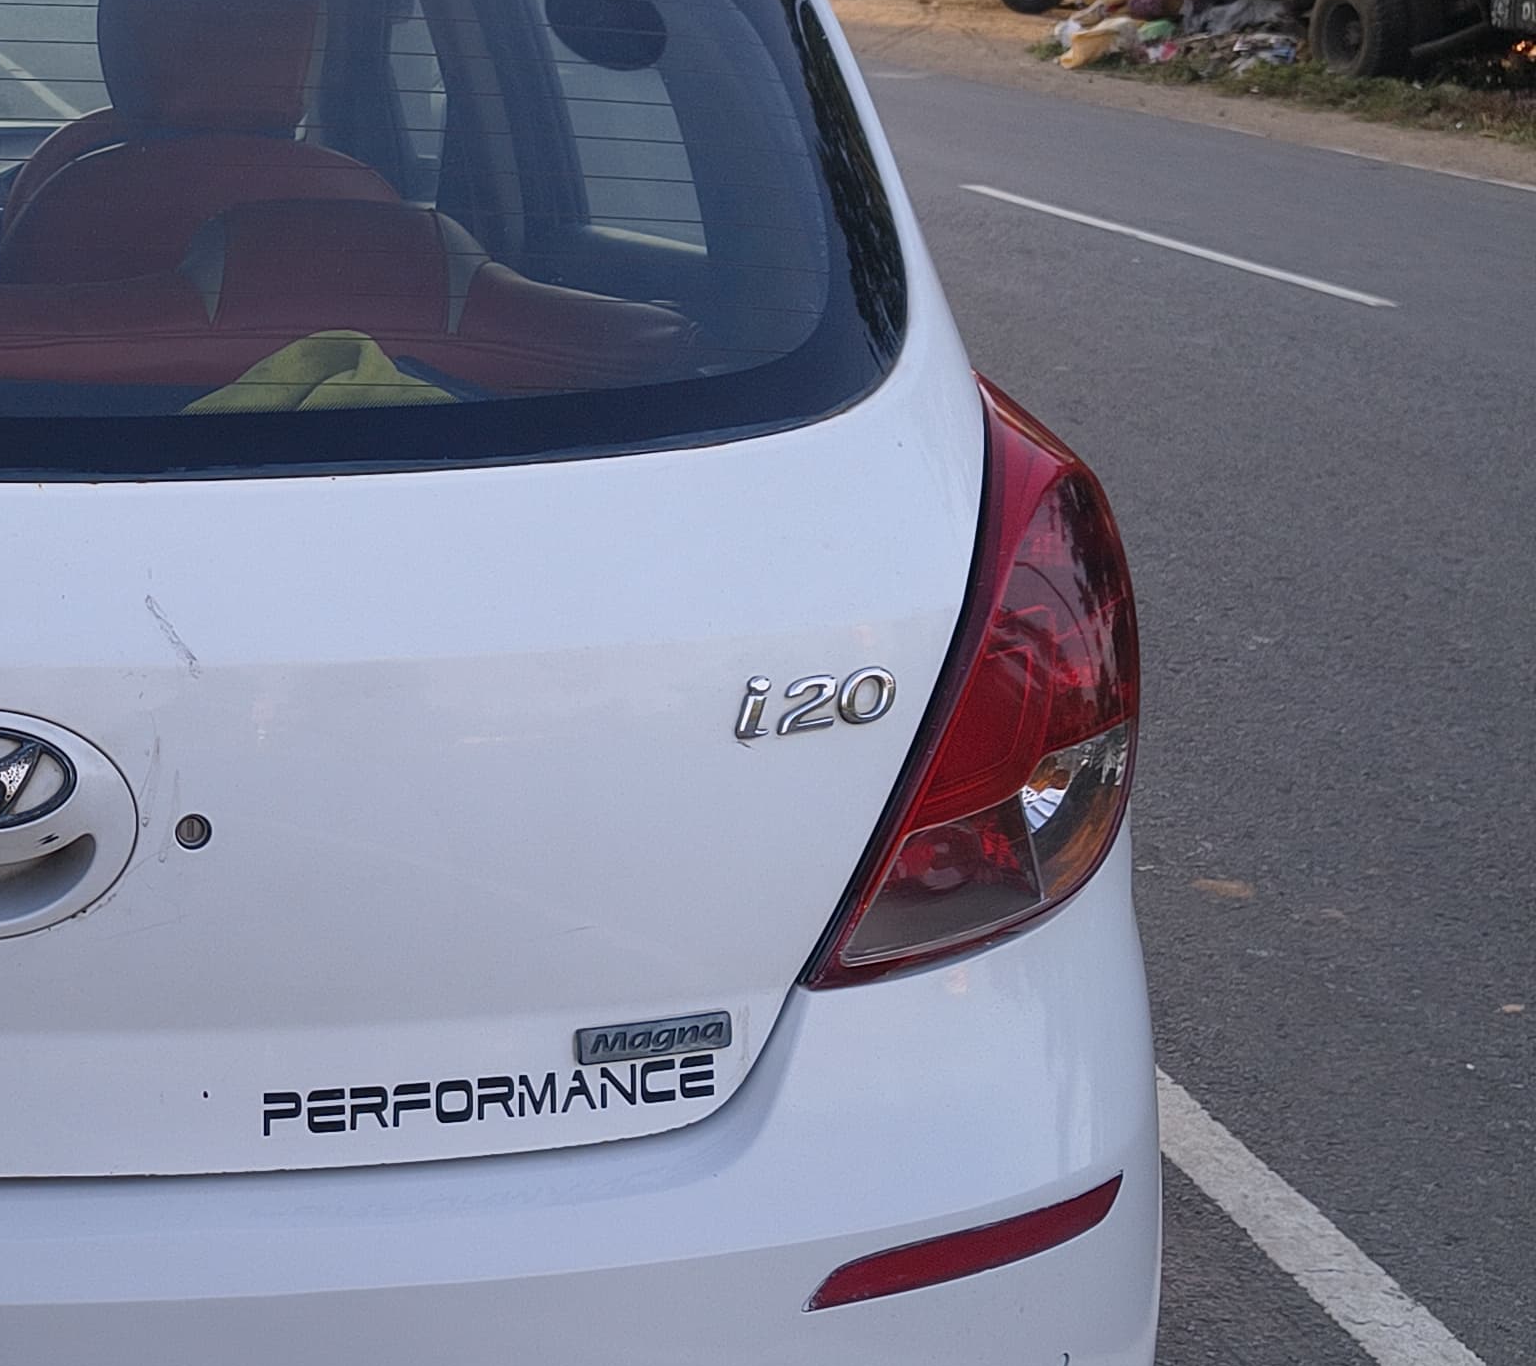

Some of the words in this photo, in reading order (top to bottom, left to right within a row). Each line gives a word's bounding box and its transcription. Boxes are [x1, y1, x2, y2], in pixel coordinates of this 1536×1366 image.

[733, 666, 897, 740] i20
[589, 1017, 726, 1056] Magna
[263, 1053, 716, 1137] PERFORMANCE
